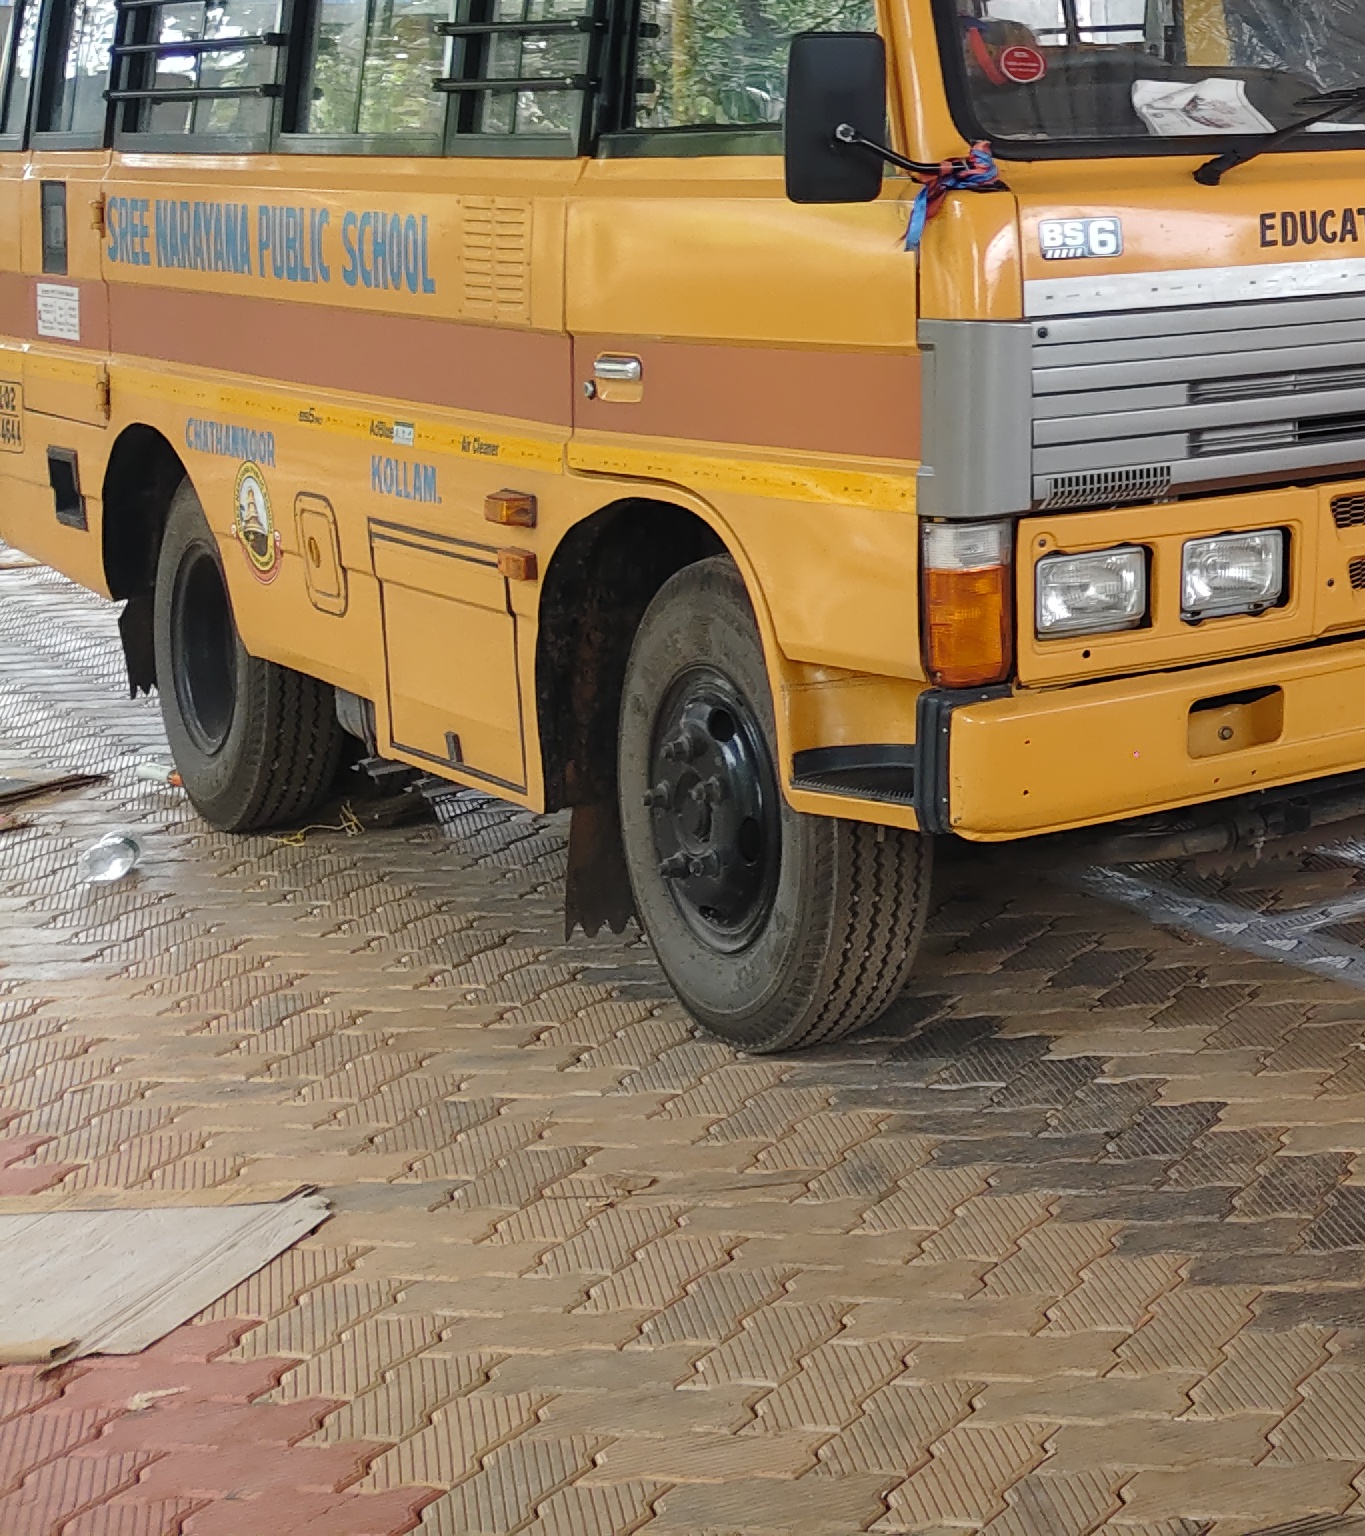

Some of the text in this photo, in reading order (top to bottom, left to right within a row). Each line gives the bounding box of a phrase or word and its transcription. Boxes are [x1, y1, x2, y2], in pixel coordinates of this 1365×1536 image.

[107, 196, 436, 294] SREE NARAYANA PUBLIC SCHOOL
[185, 417, 276, 468] CHATHANNOOR
[371, 453, 443, 504] KOLLAM.
